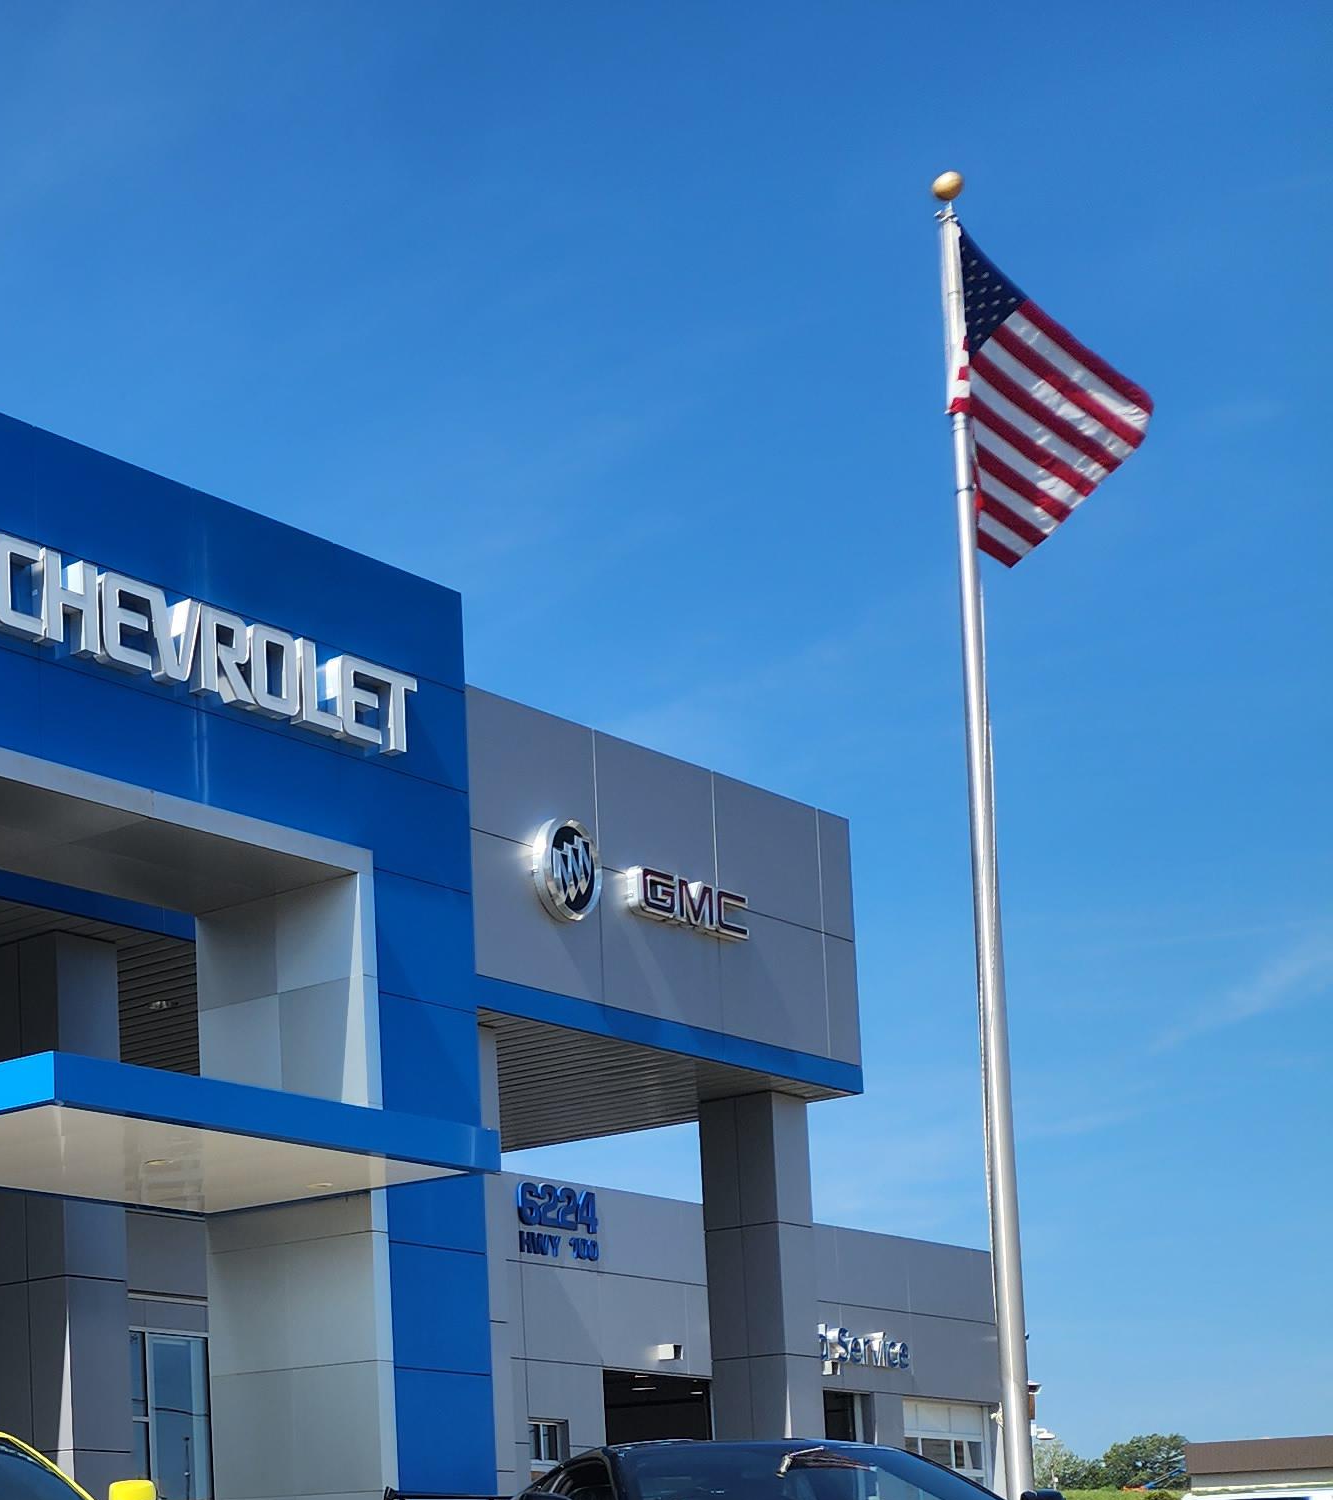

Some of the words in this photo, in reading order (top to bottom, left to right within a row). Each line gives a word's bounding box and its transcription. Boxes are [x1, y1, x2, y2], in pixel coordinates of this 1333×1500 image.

[628, 865, 750, 941] GMC
[517, 1181, 598, 1234] 6224
[518, 1230, 561, 1258] HWY
[568, 1236, 599, 1262] 100
[829, 1327, 910, 1369] Service
